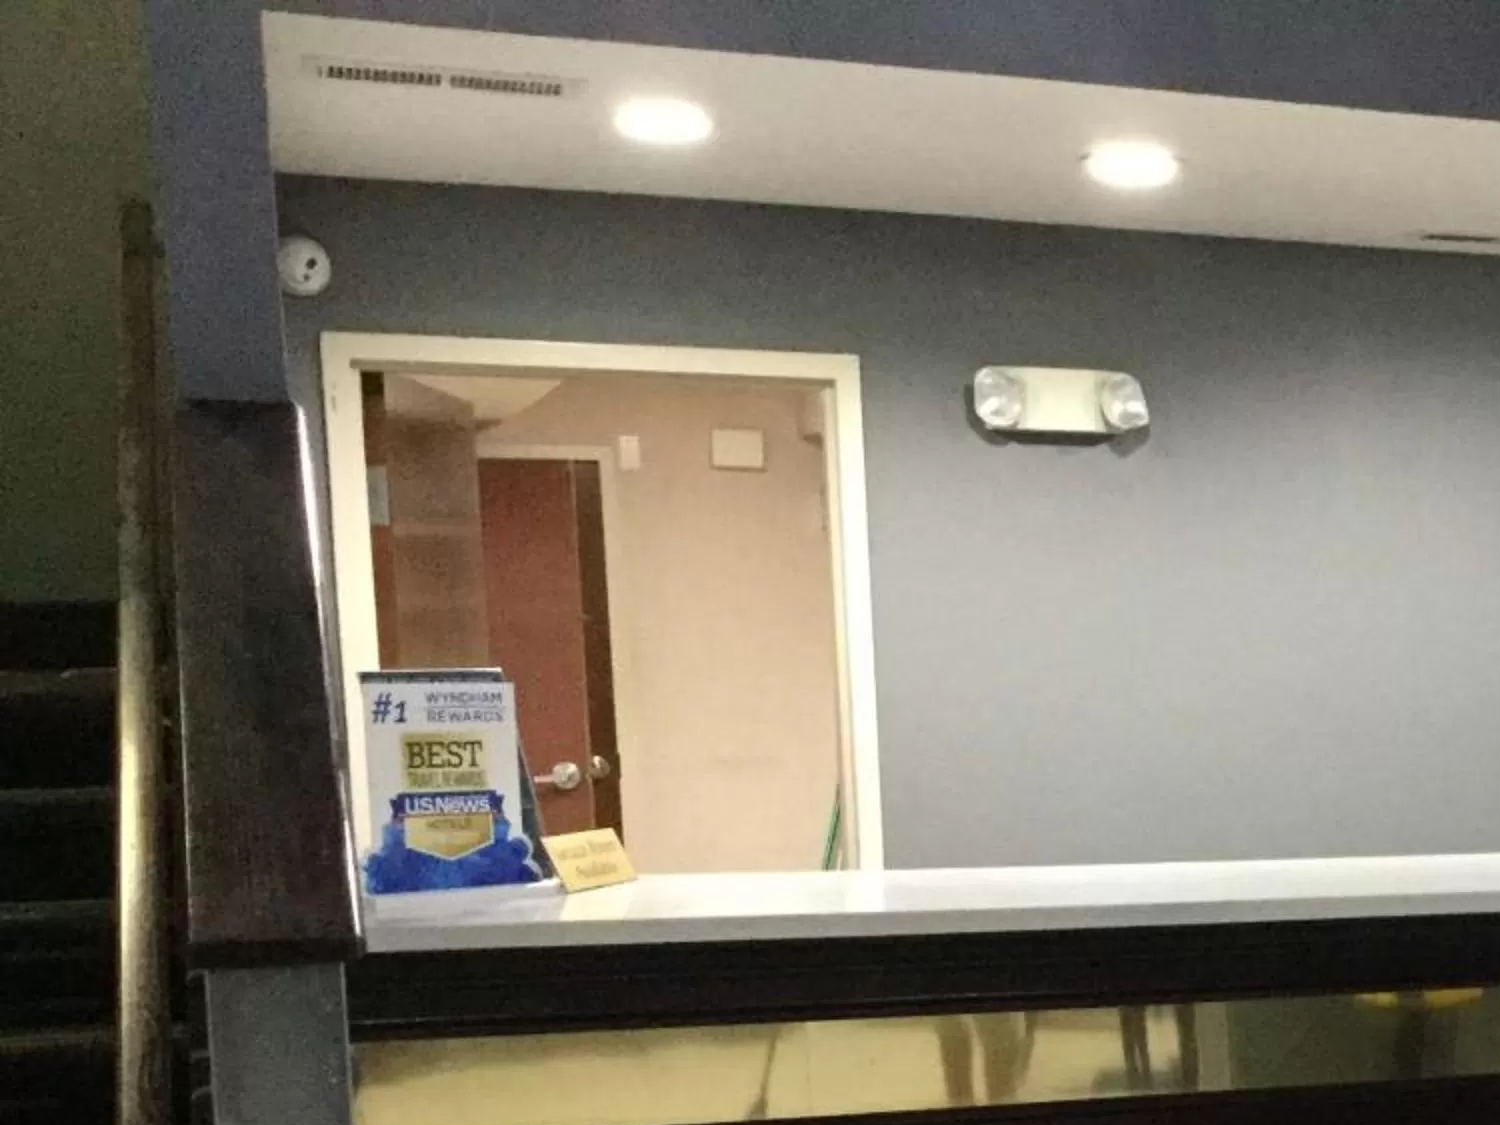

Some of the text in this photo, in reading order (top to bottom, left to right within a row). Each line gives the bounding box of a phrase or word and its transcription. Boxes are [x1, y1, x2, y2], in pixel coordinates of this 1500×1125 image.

[372, 692, 408, 724] #1
[425, 691, 503, 705] WYNDHAM
[426, 708, 504, 722] REWARDS
[405, 740, 483, 768] BEST
